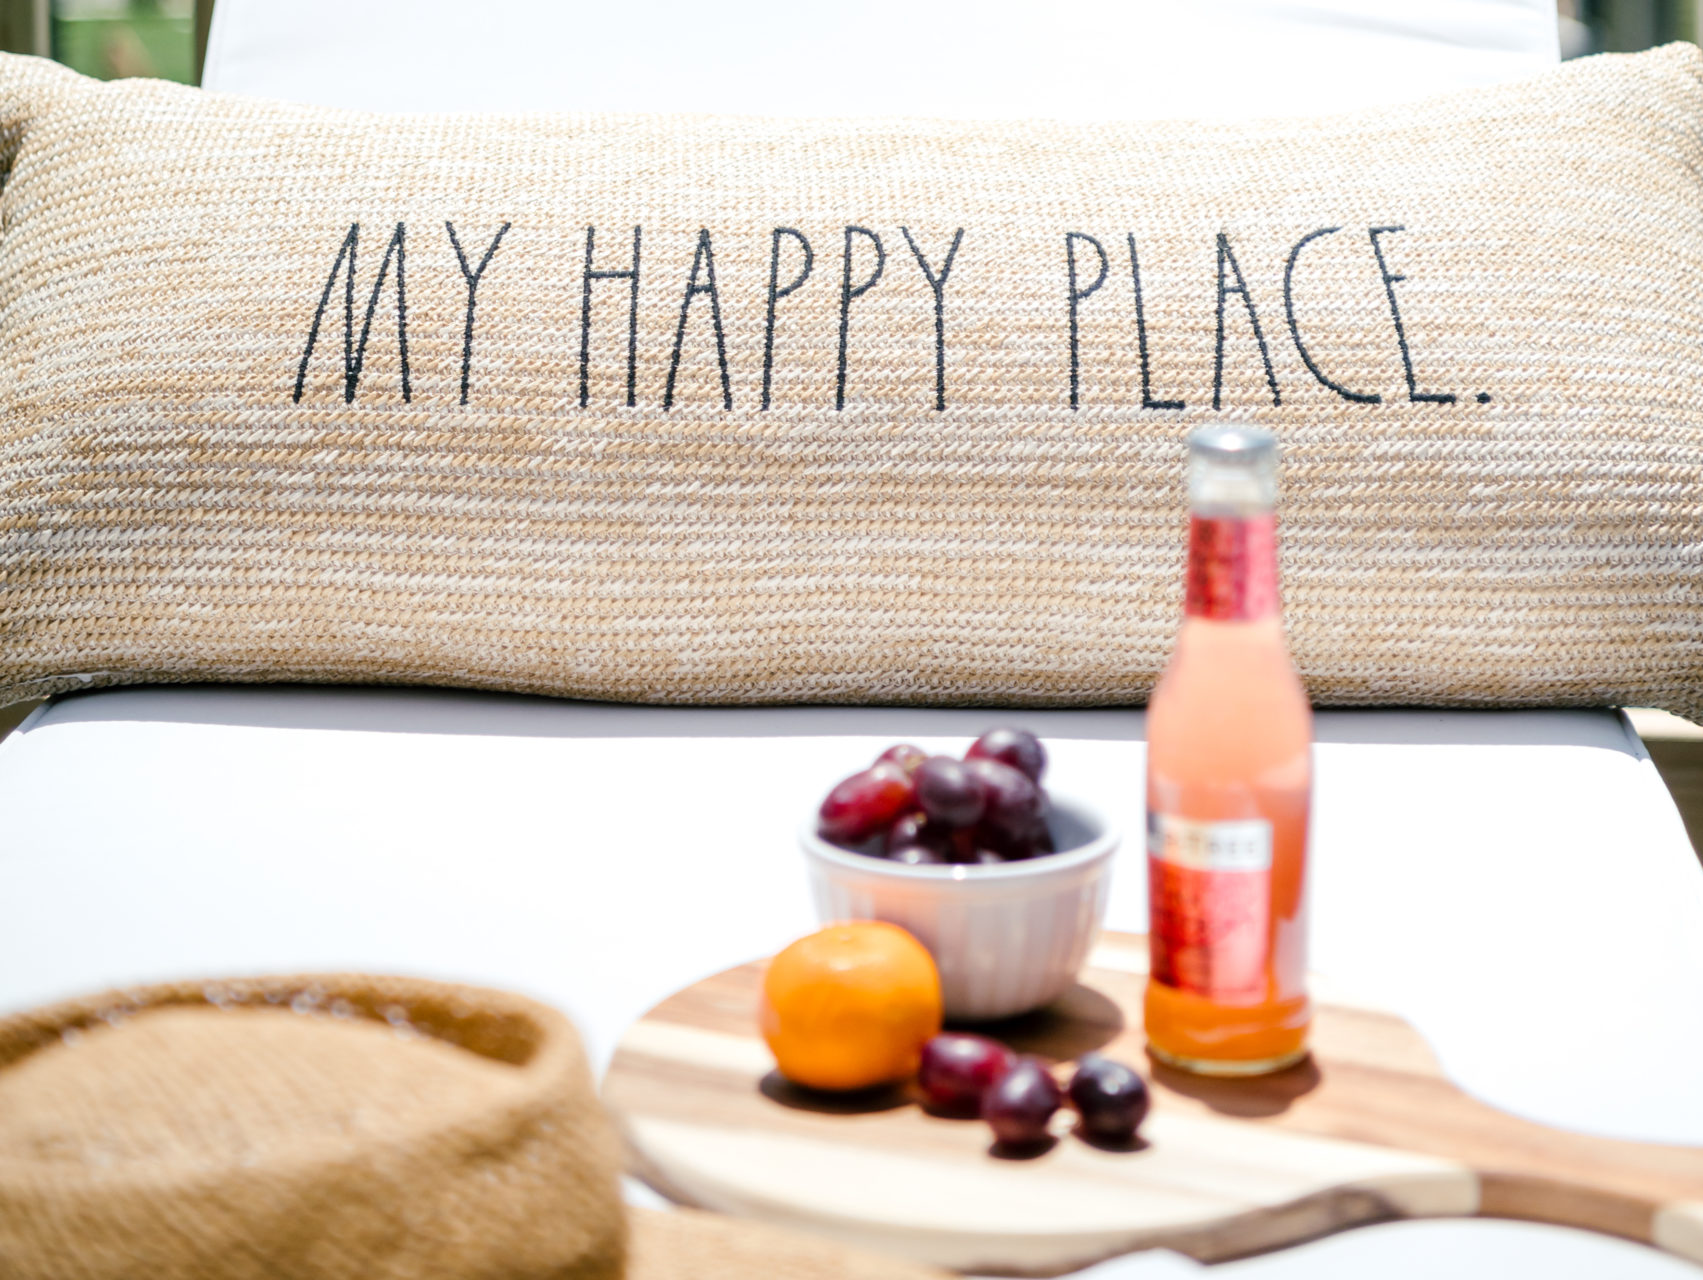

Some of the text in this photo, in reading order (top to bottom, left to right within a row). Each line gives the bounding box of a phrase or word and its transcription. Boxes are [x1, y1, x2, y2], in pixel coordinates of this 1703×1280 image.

[292, 222, 1493, 412] MY HAPPY PLACE.
